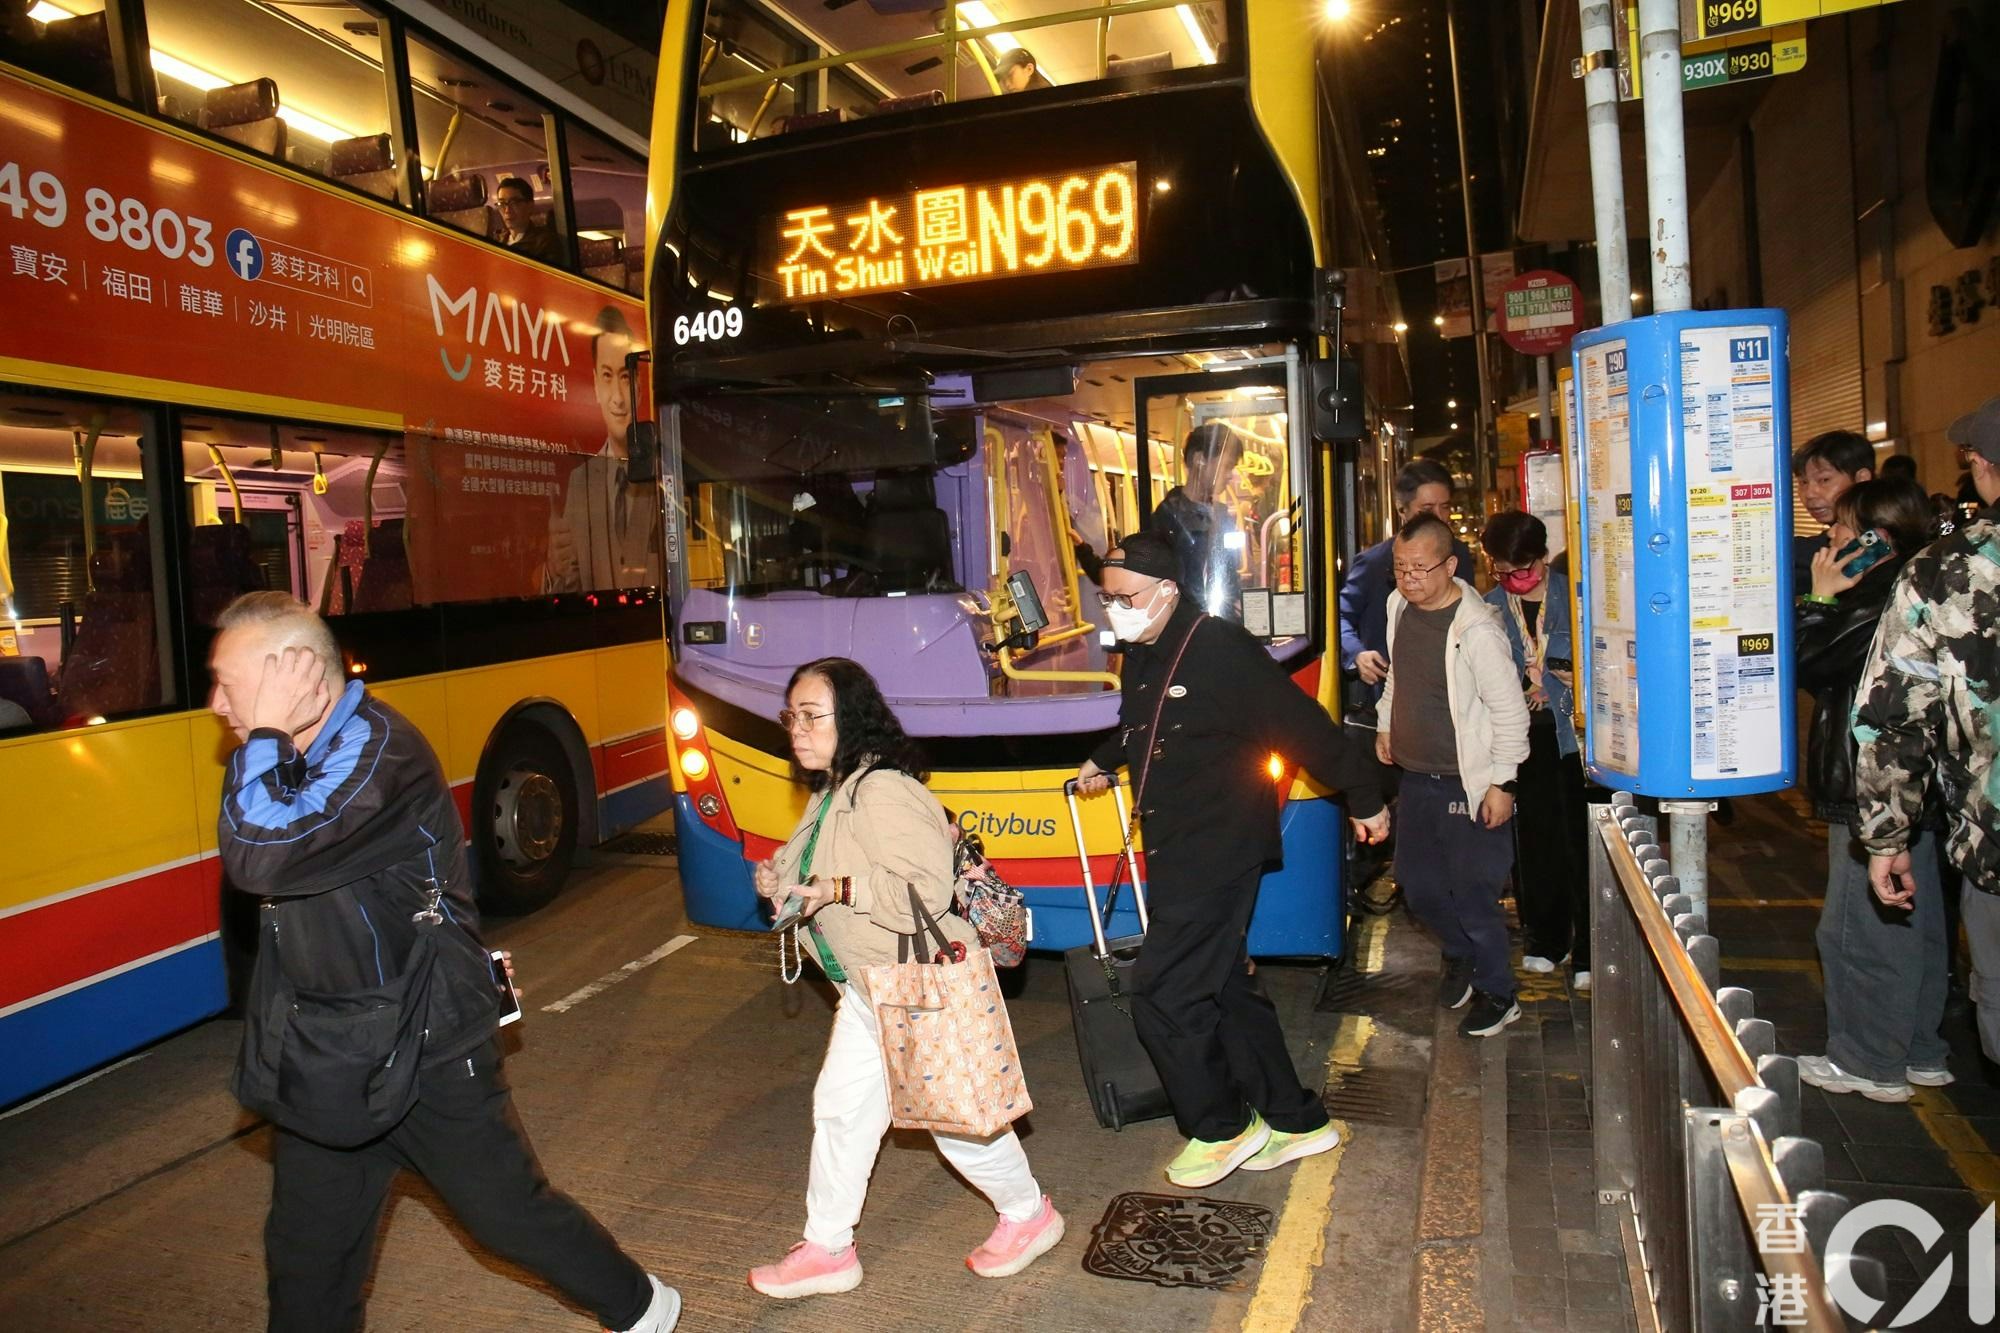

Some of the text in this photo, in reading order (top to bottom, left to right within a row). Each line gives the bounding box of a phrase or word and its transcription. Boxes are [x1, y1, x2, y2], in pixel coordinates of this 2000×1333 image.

[1708, 0, 1758, 25] N969
[1684, 51, 1770, 80] 930X N930
[85, 187, 214, 267] 8803
[783, 187, 967, 265] 天水圍
[977, 171, 1135, 273] N969
[270, 251, 340, 291] 麥芽牙科
[778, 241, 980, 298] Tin Shui Wai
[10, 244, 375, 350] 寶安 福田 龍華 沙井 光明院區
[426, 272, 570, 367] MAIYA
[673, 306, 744, 345] 6409
[1737, 339, 1762, 360] N11
[484, 358, 568, 402] 麥芽牙科
[1734, 487, 1771, 497] 307 307A
[1742, 637, 1769, 651] N969
[958, 810, 1057, 837] Citybus
[1448, 801, 1470, 815] GA
